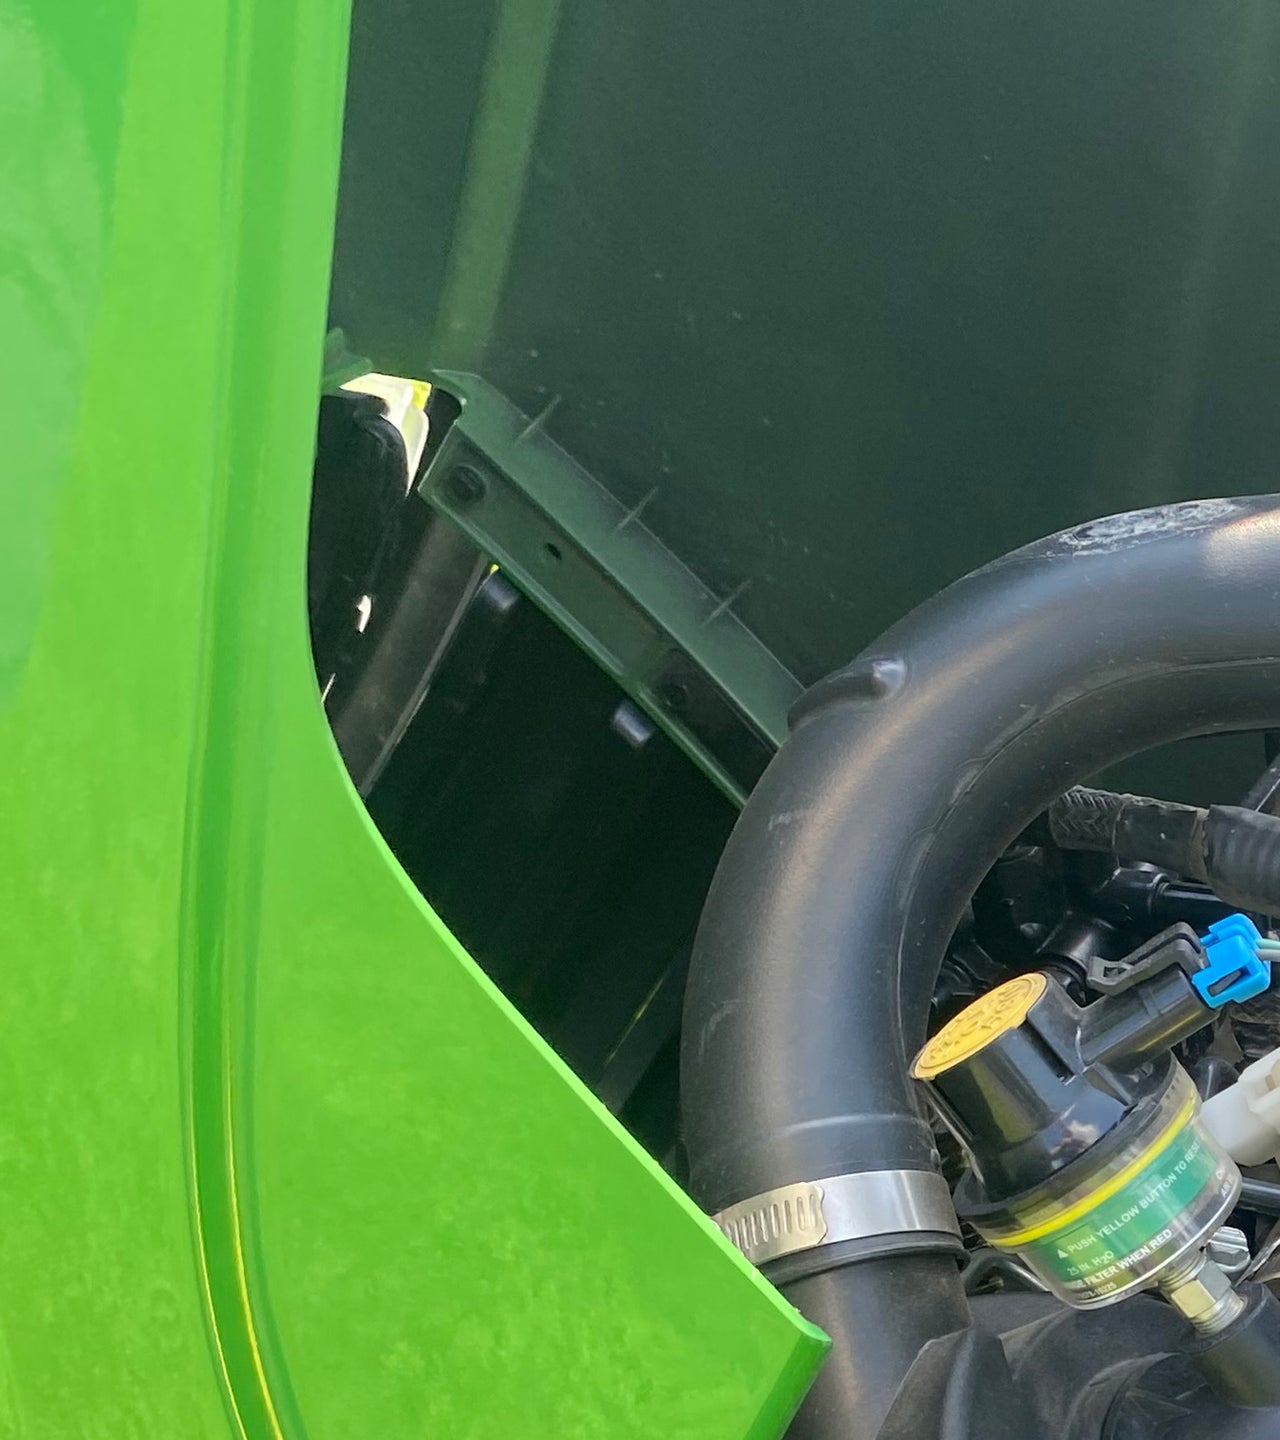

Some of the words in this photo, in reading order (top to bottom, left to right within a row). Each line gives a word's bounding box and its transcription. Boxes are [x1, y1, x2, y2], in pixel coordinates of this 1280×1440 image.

[1067, 1234, 1097, 1254] PUSH
[1097, 1204, 1140, 1238] YELLOW
[1139, 1173, 1177, 1208] BUTTON
[1174, 1160, 1188, 1175] TO
[1084, 1264, 1119, 1286] FILTER
[1117, 1245, 1151, 1270] WHEN
[1149, 1229, 1173, 1250] RED
